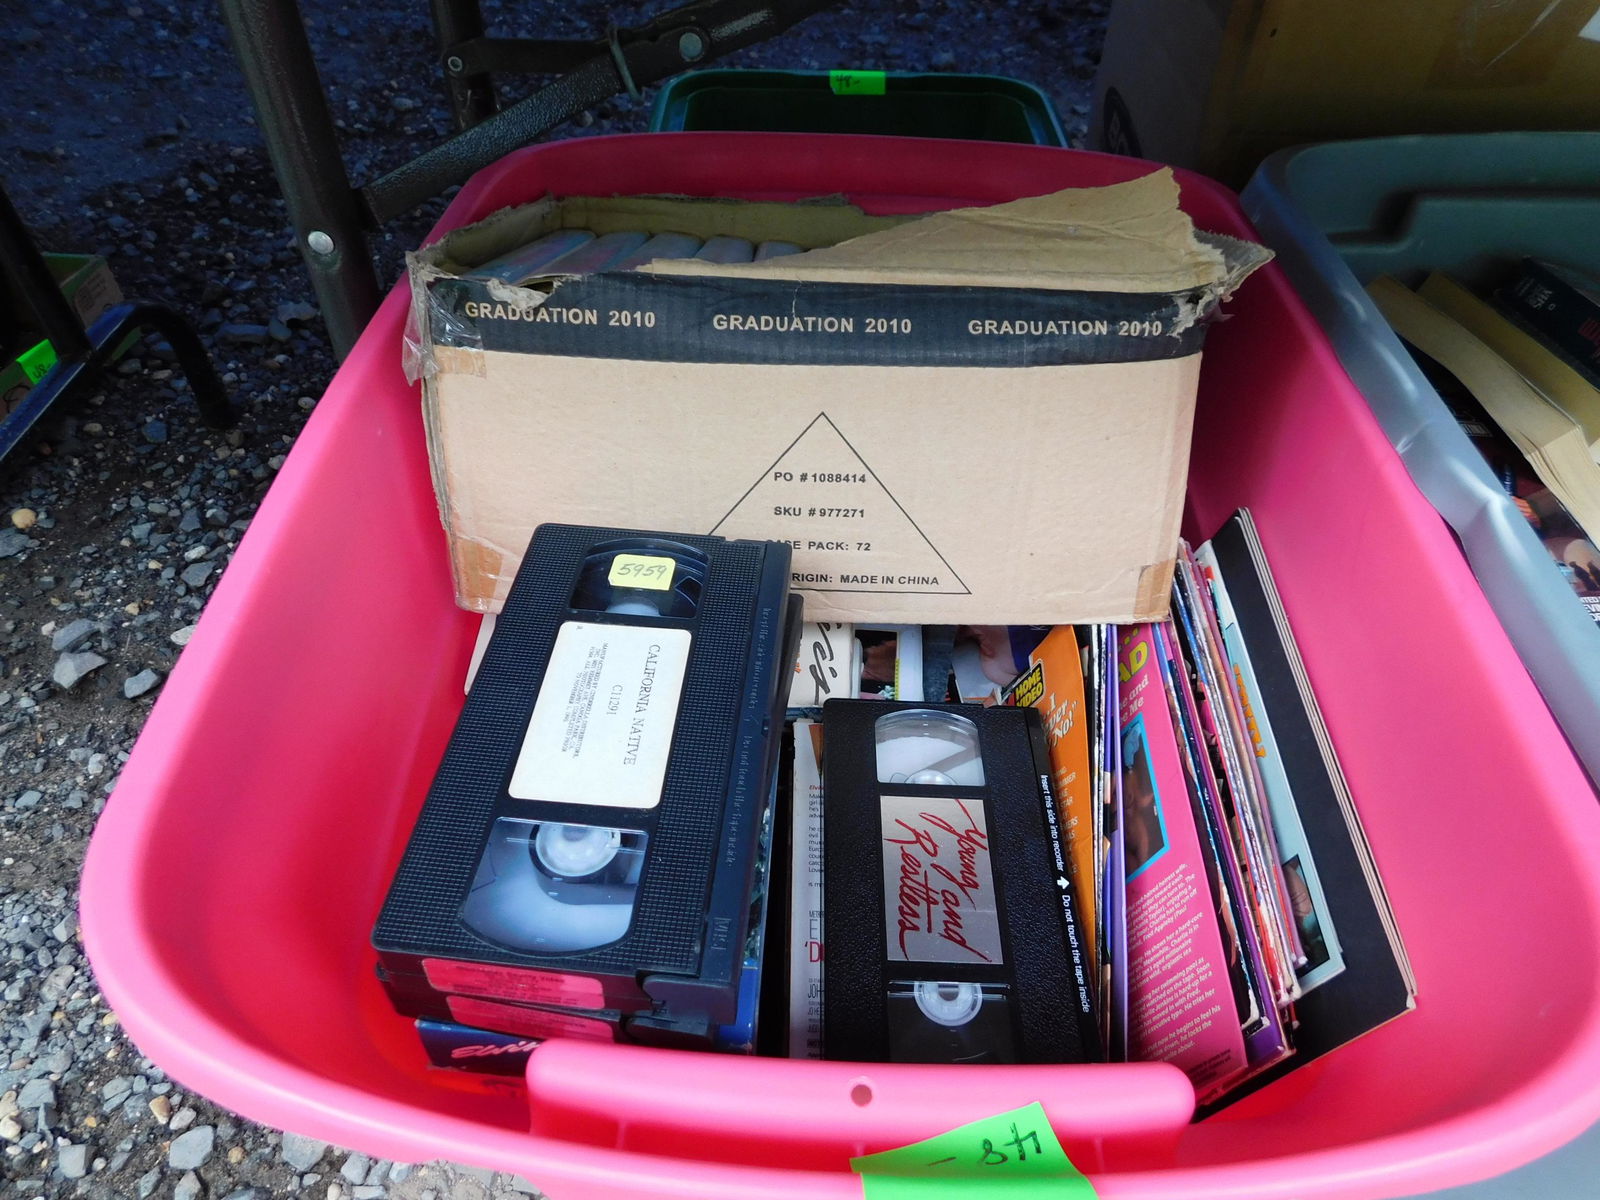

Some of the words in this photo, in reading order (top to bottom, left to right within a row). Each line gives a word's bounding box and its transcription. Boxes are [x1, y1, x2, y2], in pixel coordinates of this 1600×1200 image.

[465, 301, 598, 325] GRADUATION
[608, 310, 656, 328] 2010
[713, 314, 854, 333] GRADUATION
[864, 318, 912, 334] 2010
[968, 319, 1108, 336] GRADUATION
[1117, 320, 1162, 337] 2010
[774, 471, 793, 482] PO
[773, 506, 802, 517] SKU
[808, 541, 849, 551] PACK:
[856, 542, 872, 552] 72
[617, 563, 667, 581] 5959
[791, 572, 833, 584] RIGIN:
[840, 574, 878, 585] MADE
[881, 575, 894, 585] IN
[898, 575, 940, 585] CHINA
[634, 643, 661, 715] CALIFORNIA
[1015, 667, 1042, 699] HOME
[606, 683, 622, 716] C11291
[1016, 682, 1043, 707] VIDEO
[623, 717, 644, 766] NATIVE
[1040, 774, 1050, 795] Insert
[1044, 795, 1054, 808] this
[1046, 808, 1056, 825] side
[1049, 825, 1059, 839] into
[918, 798, 989, 911] Young
[1052, 839, 1065, 872] recorder
[883, 819, 940, 961] Restless
[1061, 894, 1071, 907] Do
[1063, 907, 1073, 922] not
[938, 888, 993, 963] and
[1066, 922, 1078, 948] touch
[1071, 948, 1081, 963] the
[1073, 964, 1085, 986] tape
[1078, 986, 1090, 1013] inside
